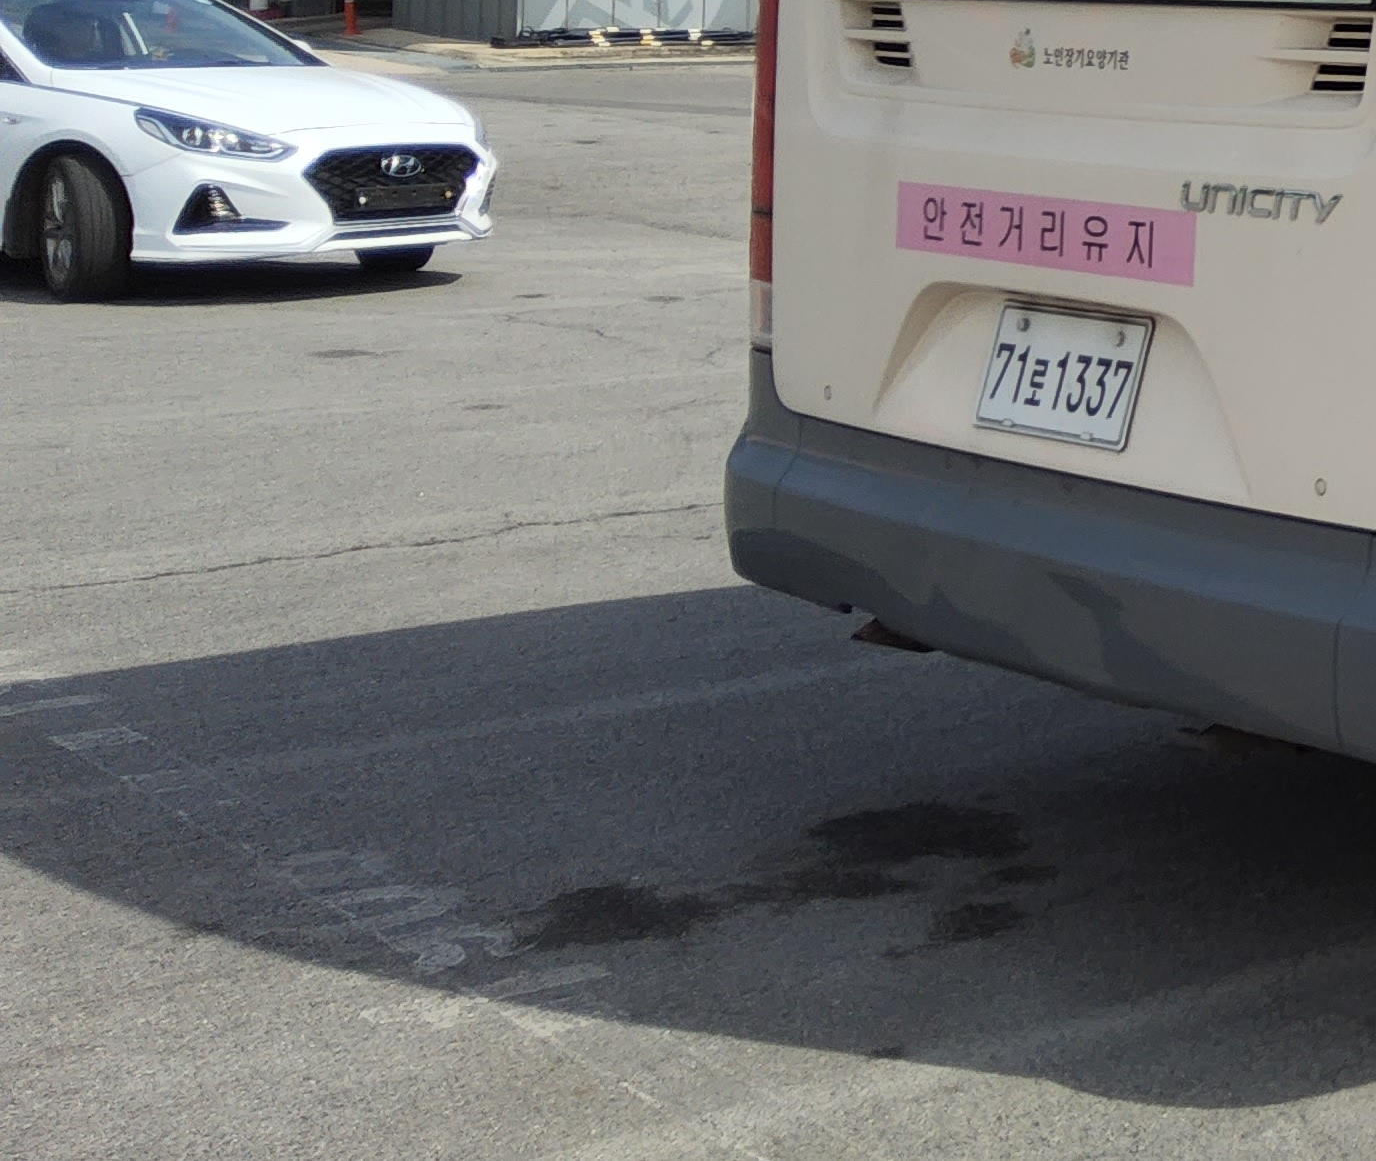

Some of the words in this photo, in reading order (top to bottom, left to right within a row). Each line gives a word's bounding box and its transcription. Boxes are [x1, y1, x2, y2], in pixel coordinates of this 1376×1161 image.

[922, 196, 1155, 269] 안전거리유지
[1180, 180, 1344, 225] UNICITY
[988, 342, 1134, 419] 71로1337
